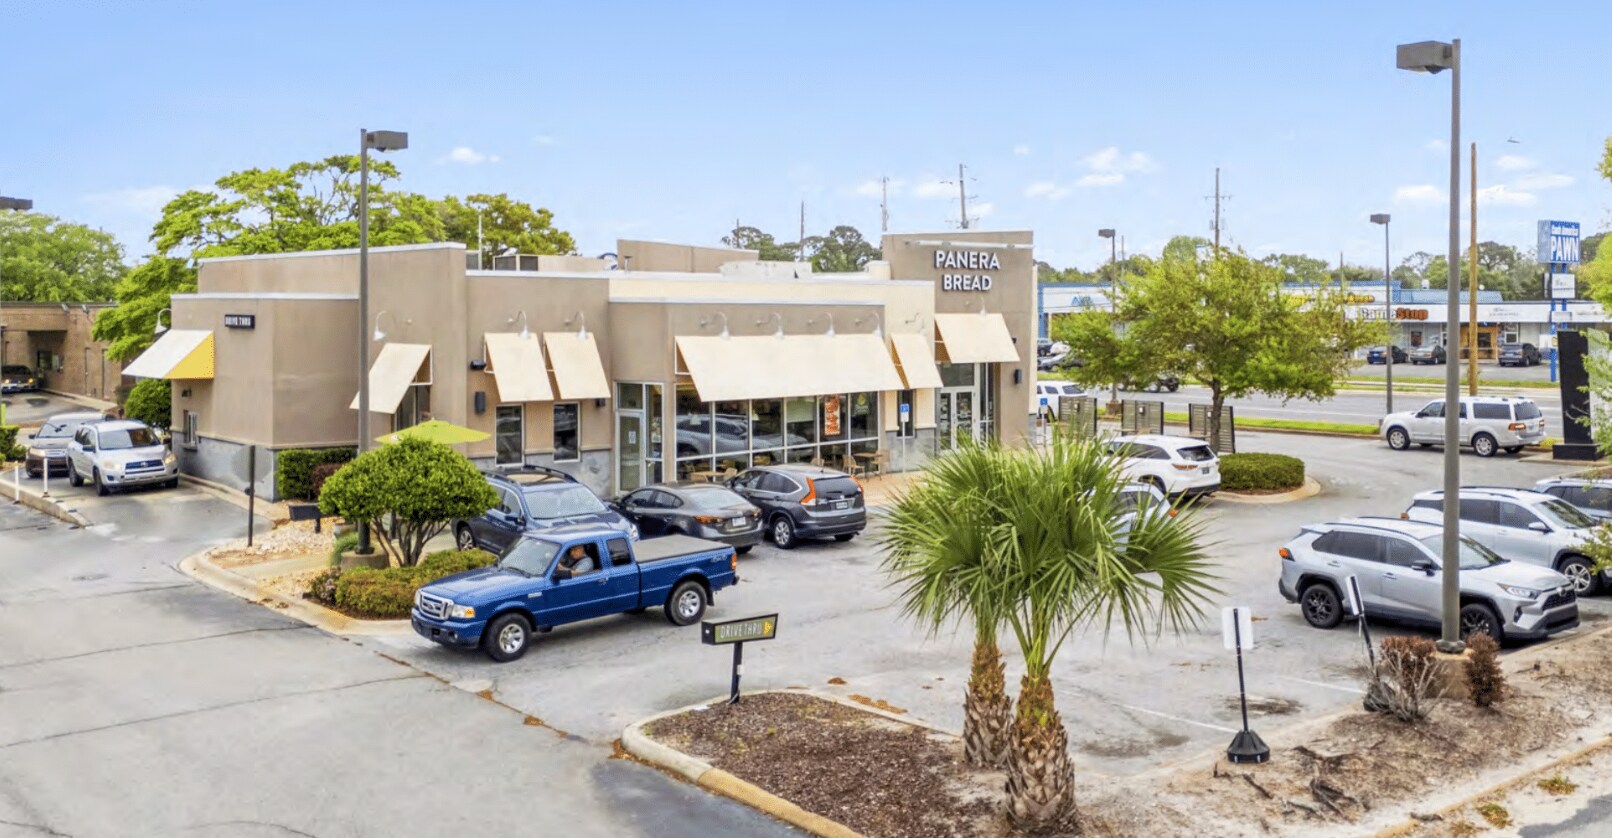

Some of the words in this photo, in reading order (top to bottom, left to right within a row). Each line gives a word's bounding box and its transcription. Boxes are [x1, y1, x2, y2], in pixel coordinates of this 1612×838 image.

[1550, 234, 1579, 261] PAWN
[934, 250, 1001, 270] PANERA
[942, 274, 992, 291] BREAD
[720, 624, 743, 639] DRIVE
[744, 621, 763, 636] THRU
